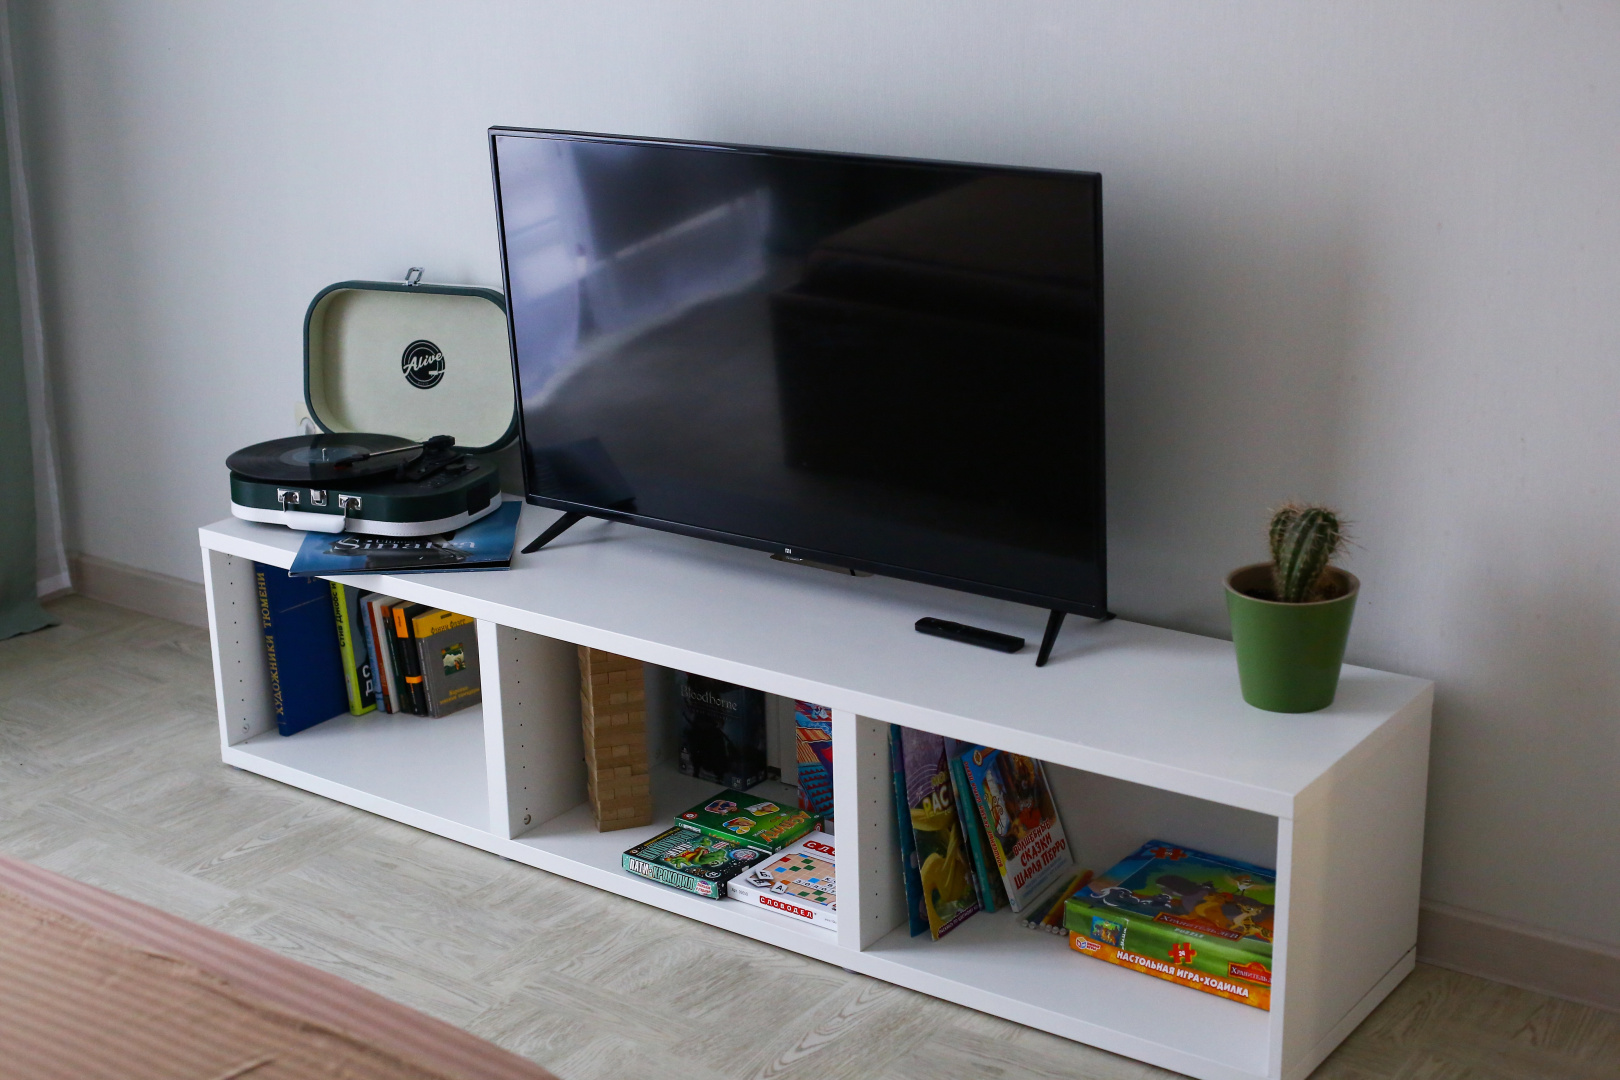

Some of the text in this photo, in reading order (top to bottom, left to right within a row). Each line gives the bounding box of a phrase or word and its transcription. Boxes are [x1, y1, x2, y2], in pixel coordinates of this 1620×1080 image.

[403, 352, 443, 377] Alive
[257, 572, 284, 716] ХУДОЖНИКИ ТЮМЕНИ
[1012, 819, 1051, 856] ВОЛШЕБНЫЕ
[1020, 832, 1052, 866] СКАЗКИ
[1014, 860, 1042, 890] ШАРЛЯ
[1041, 838, 1066, 866] ПЕРРО
[760, 896, 813, 918] СЛОВОДЕЛ
[1116, 950, 1175, 976] НАСТОЛЬНАЯ
